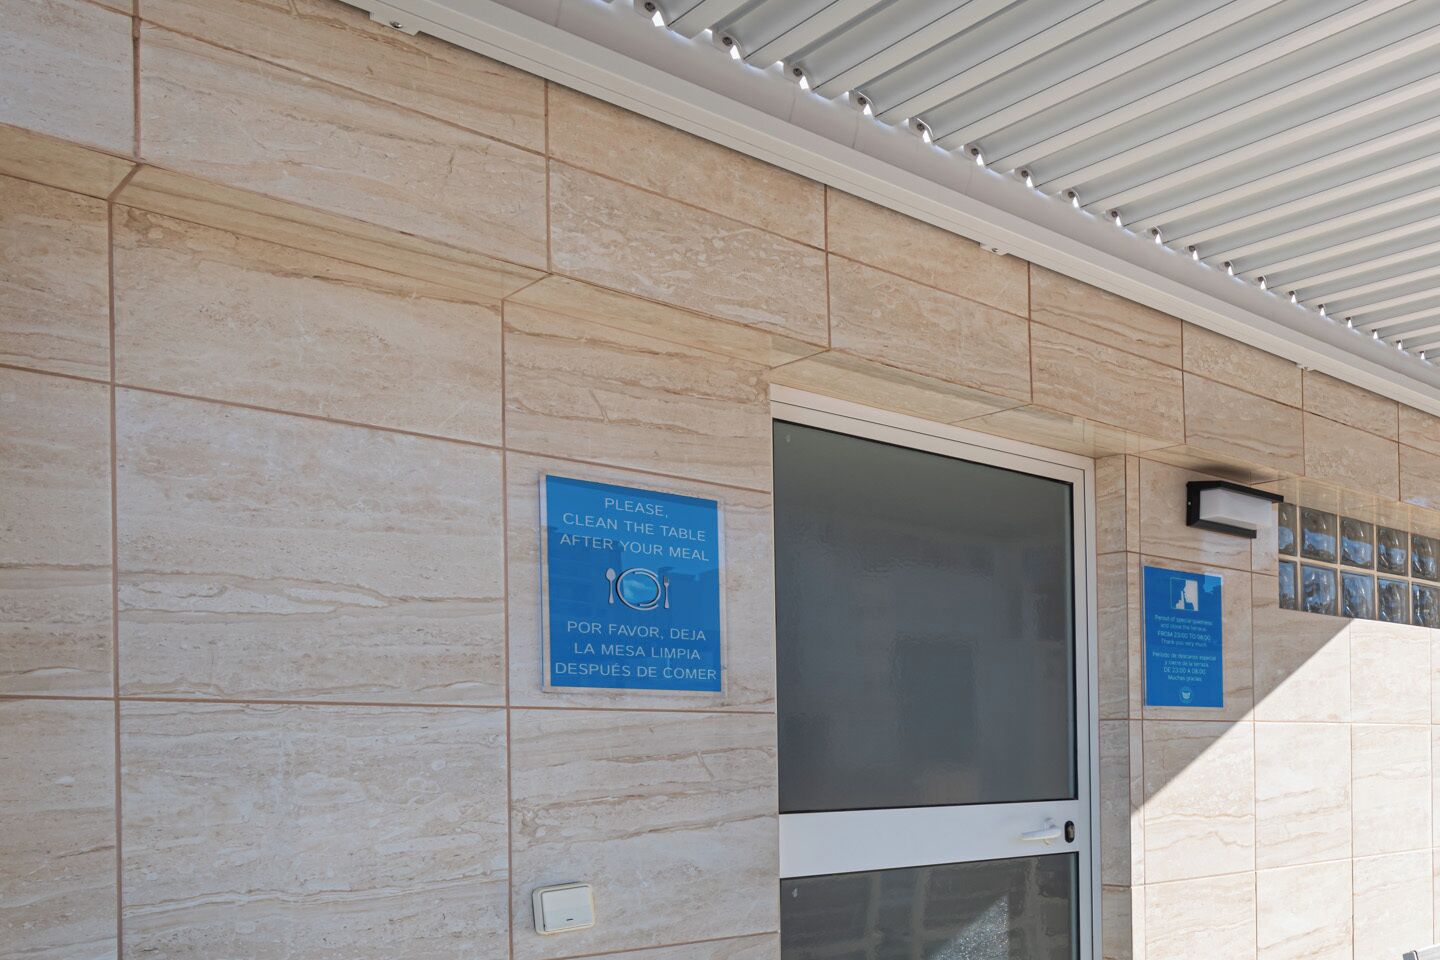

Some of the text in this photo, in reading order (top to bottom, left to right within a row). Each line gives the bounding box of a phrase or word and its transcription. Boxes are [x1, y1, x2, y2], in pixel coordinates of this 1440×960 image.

[604, 497, 669, 519] PLEASE,
[562, 512, 707, 543] CLEAN THE TABLE
[559, 533, 710, 562] AFTER YOUR MEAL
[566, 620, 707, 641] POR FAVOR, DEJA
[573, 642, 701, 661] LA MESA LIMPIA
[554, 661, 717, 681] DESPUÉS DE COMER
